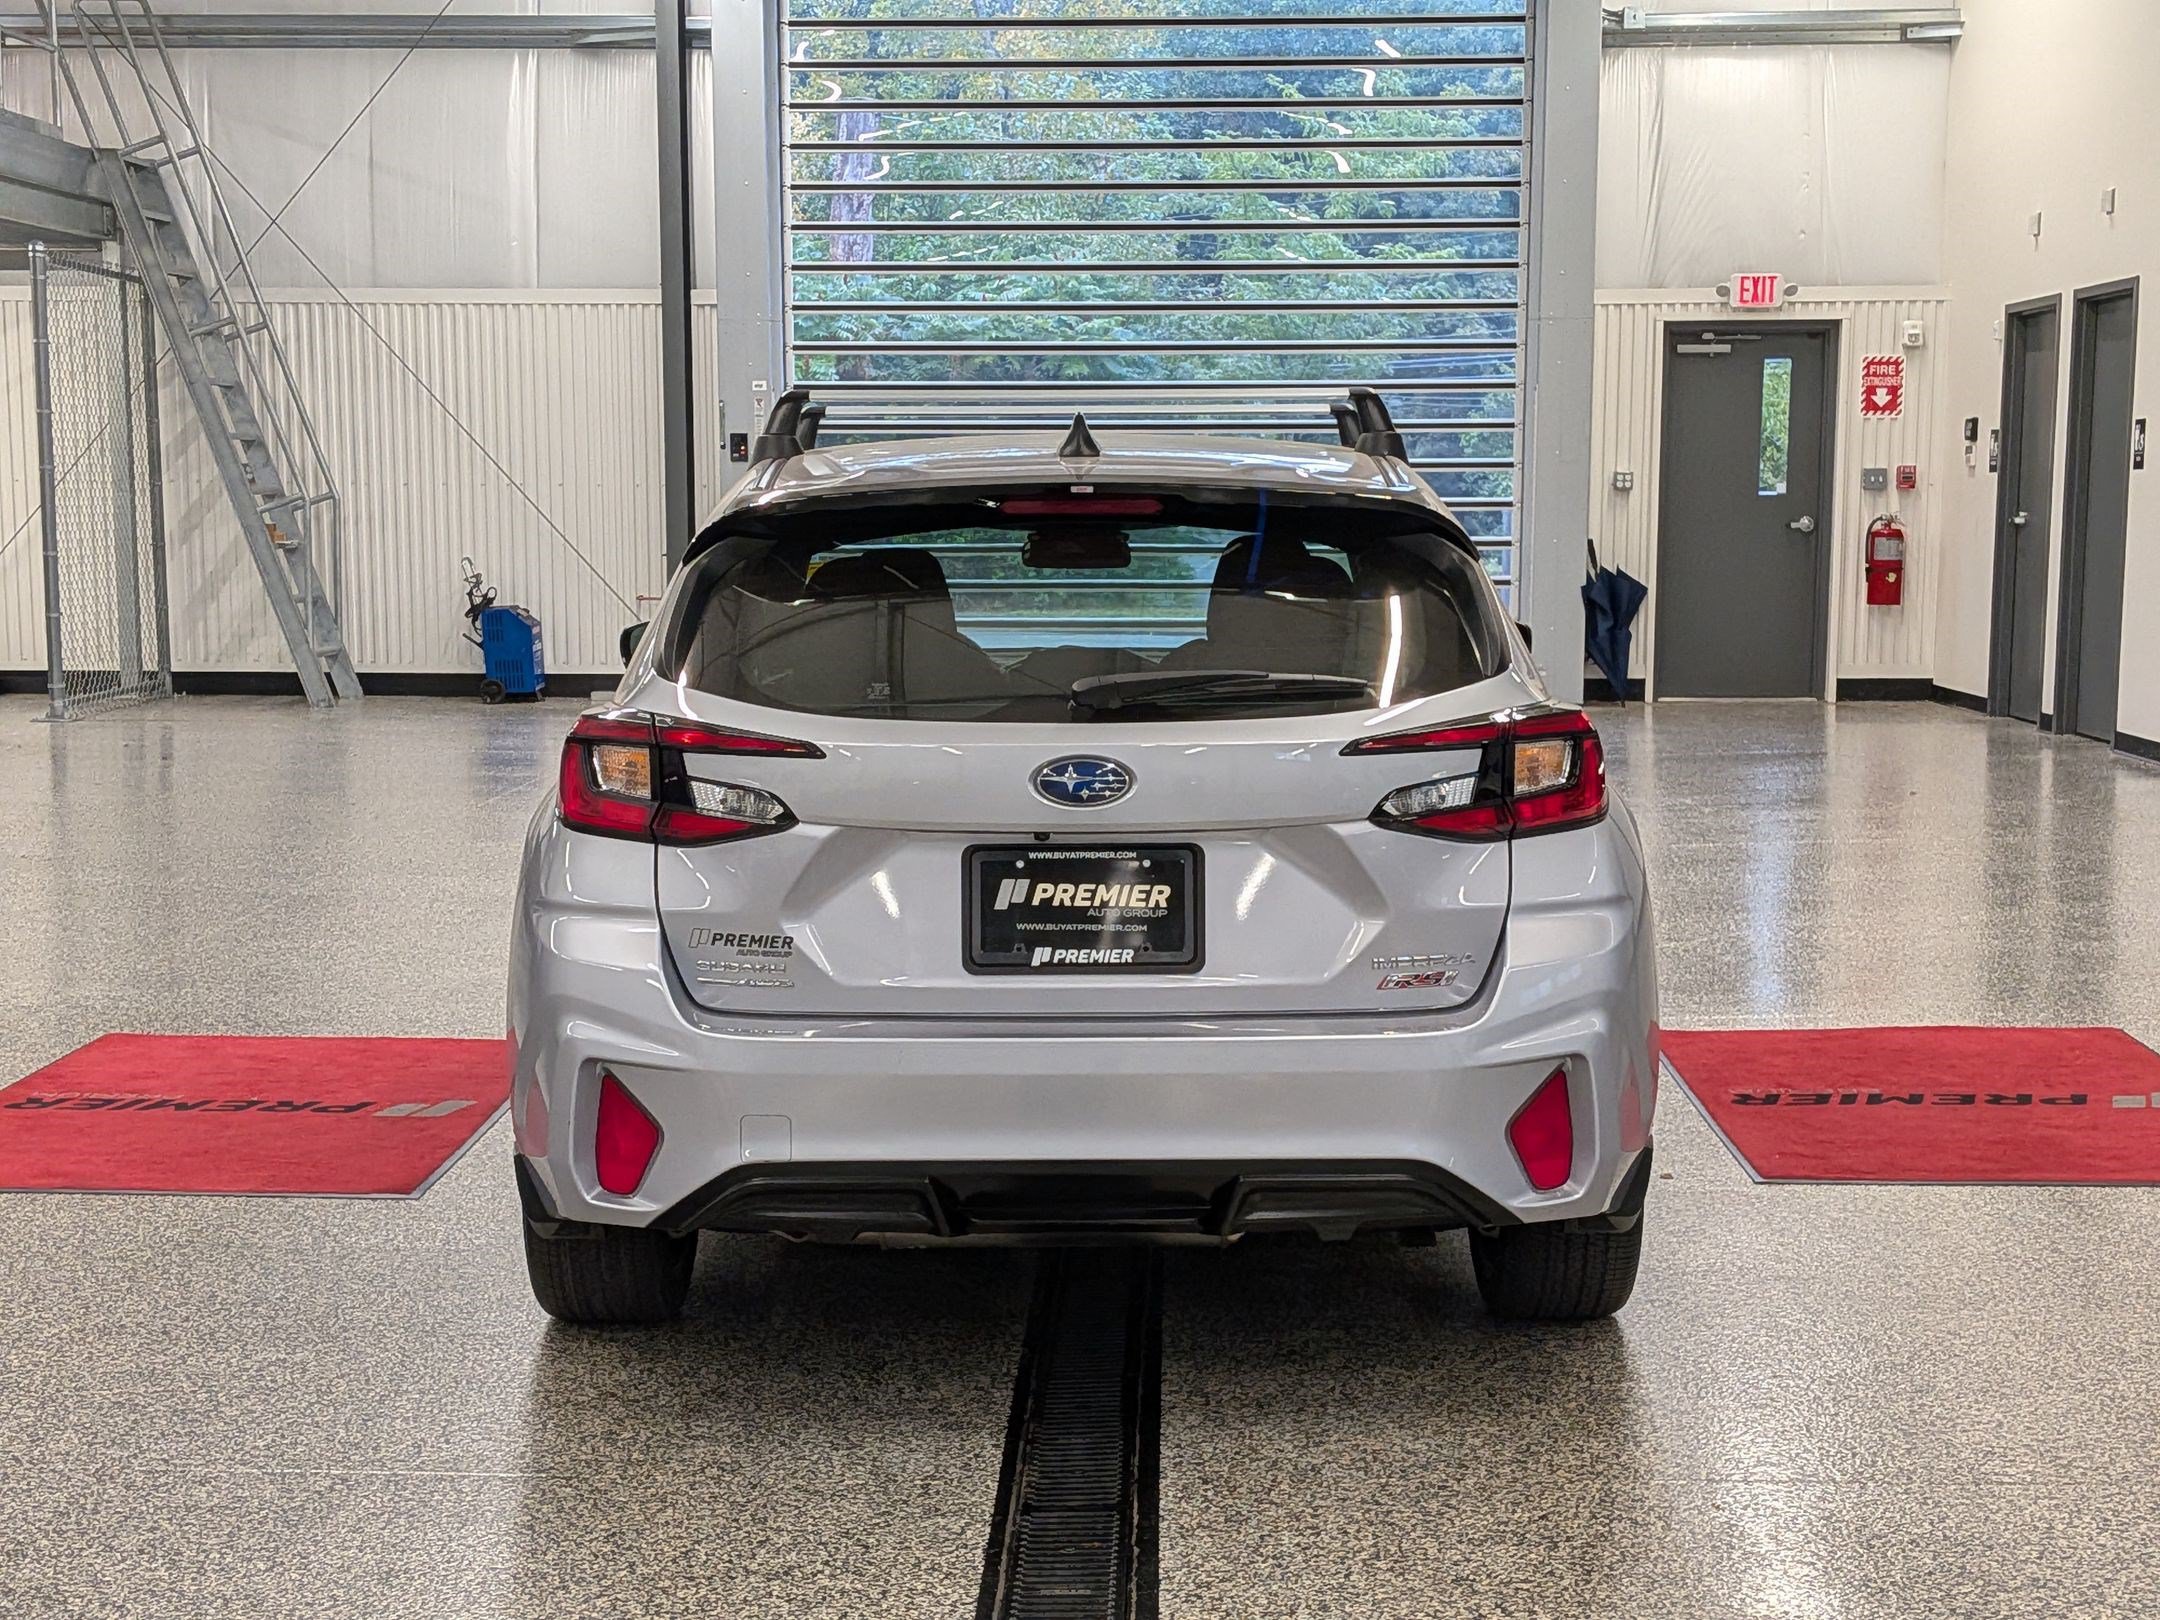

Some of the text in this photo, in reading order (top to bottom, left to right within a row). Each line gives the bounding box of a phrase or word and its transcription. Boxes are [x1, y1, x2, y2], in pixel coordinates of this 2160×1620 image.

[1739, 276, 1777, 303] EXIT
[1869, 364, 1896, 376] FIRE
[1028, 851, 1137, 859] WWW.BUYATPREMIER.COM
[1031, 883, 1172, 907] PREMIER
[1087, 908, 1168, 918] AUTO GROUP
[1016, 923, 1147, 932] WWW.BUYATPREMIER.COM
[711, 933, 794, 949] PREMIER
[1053, 949, 1134, 964] PREMIER
[3, 1098, 378, 1112] PREMIER
[1730, 1093, 2088, 1105] PREMIER
